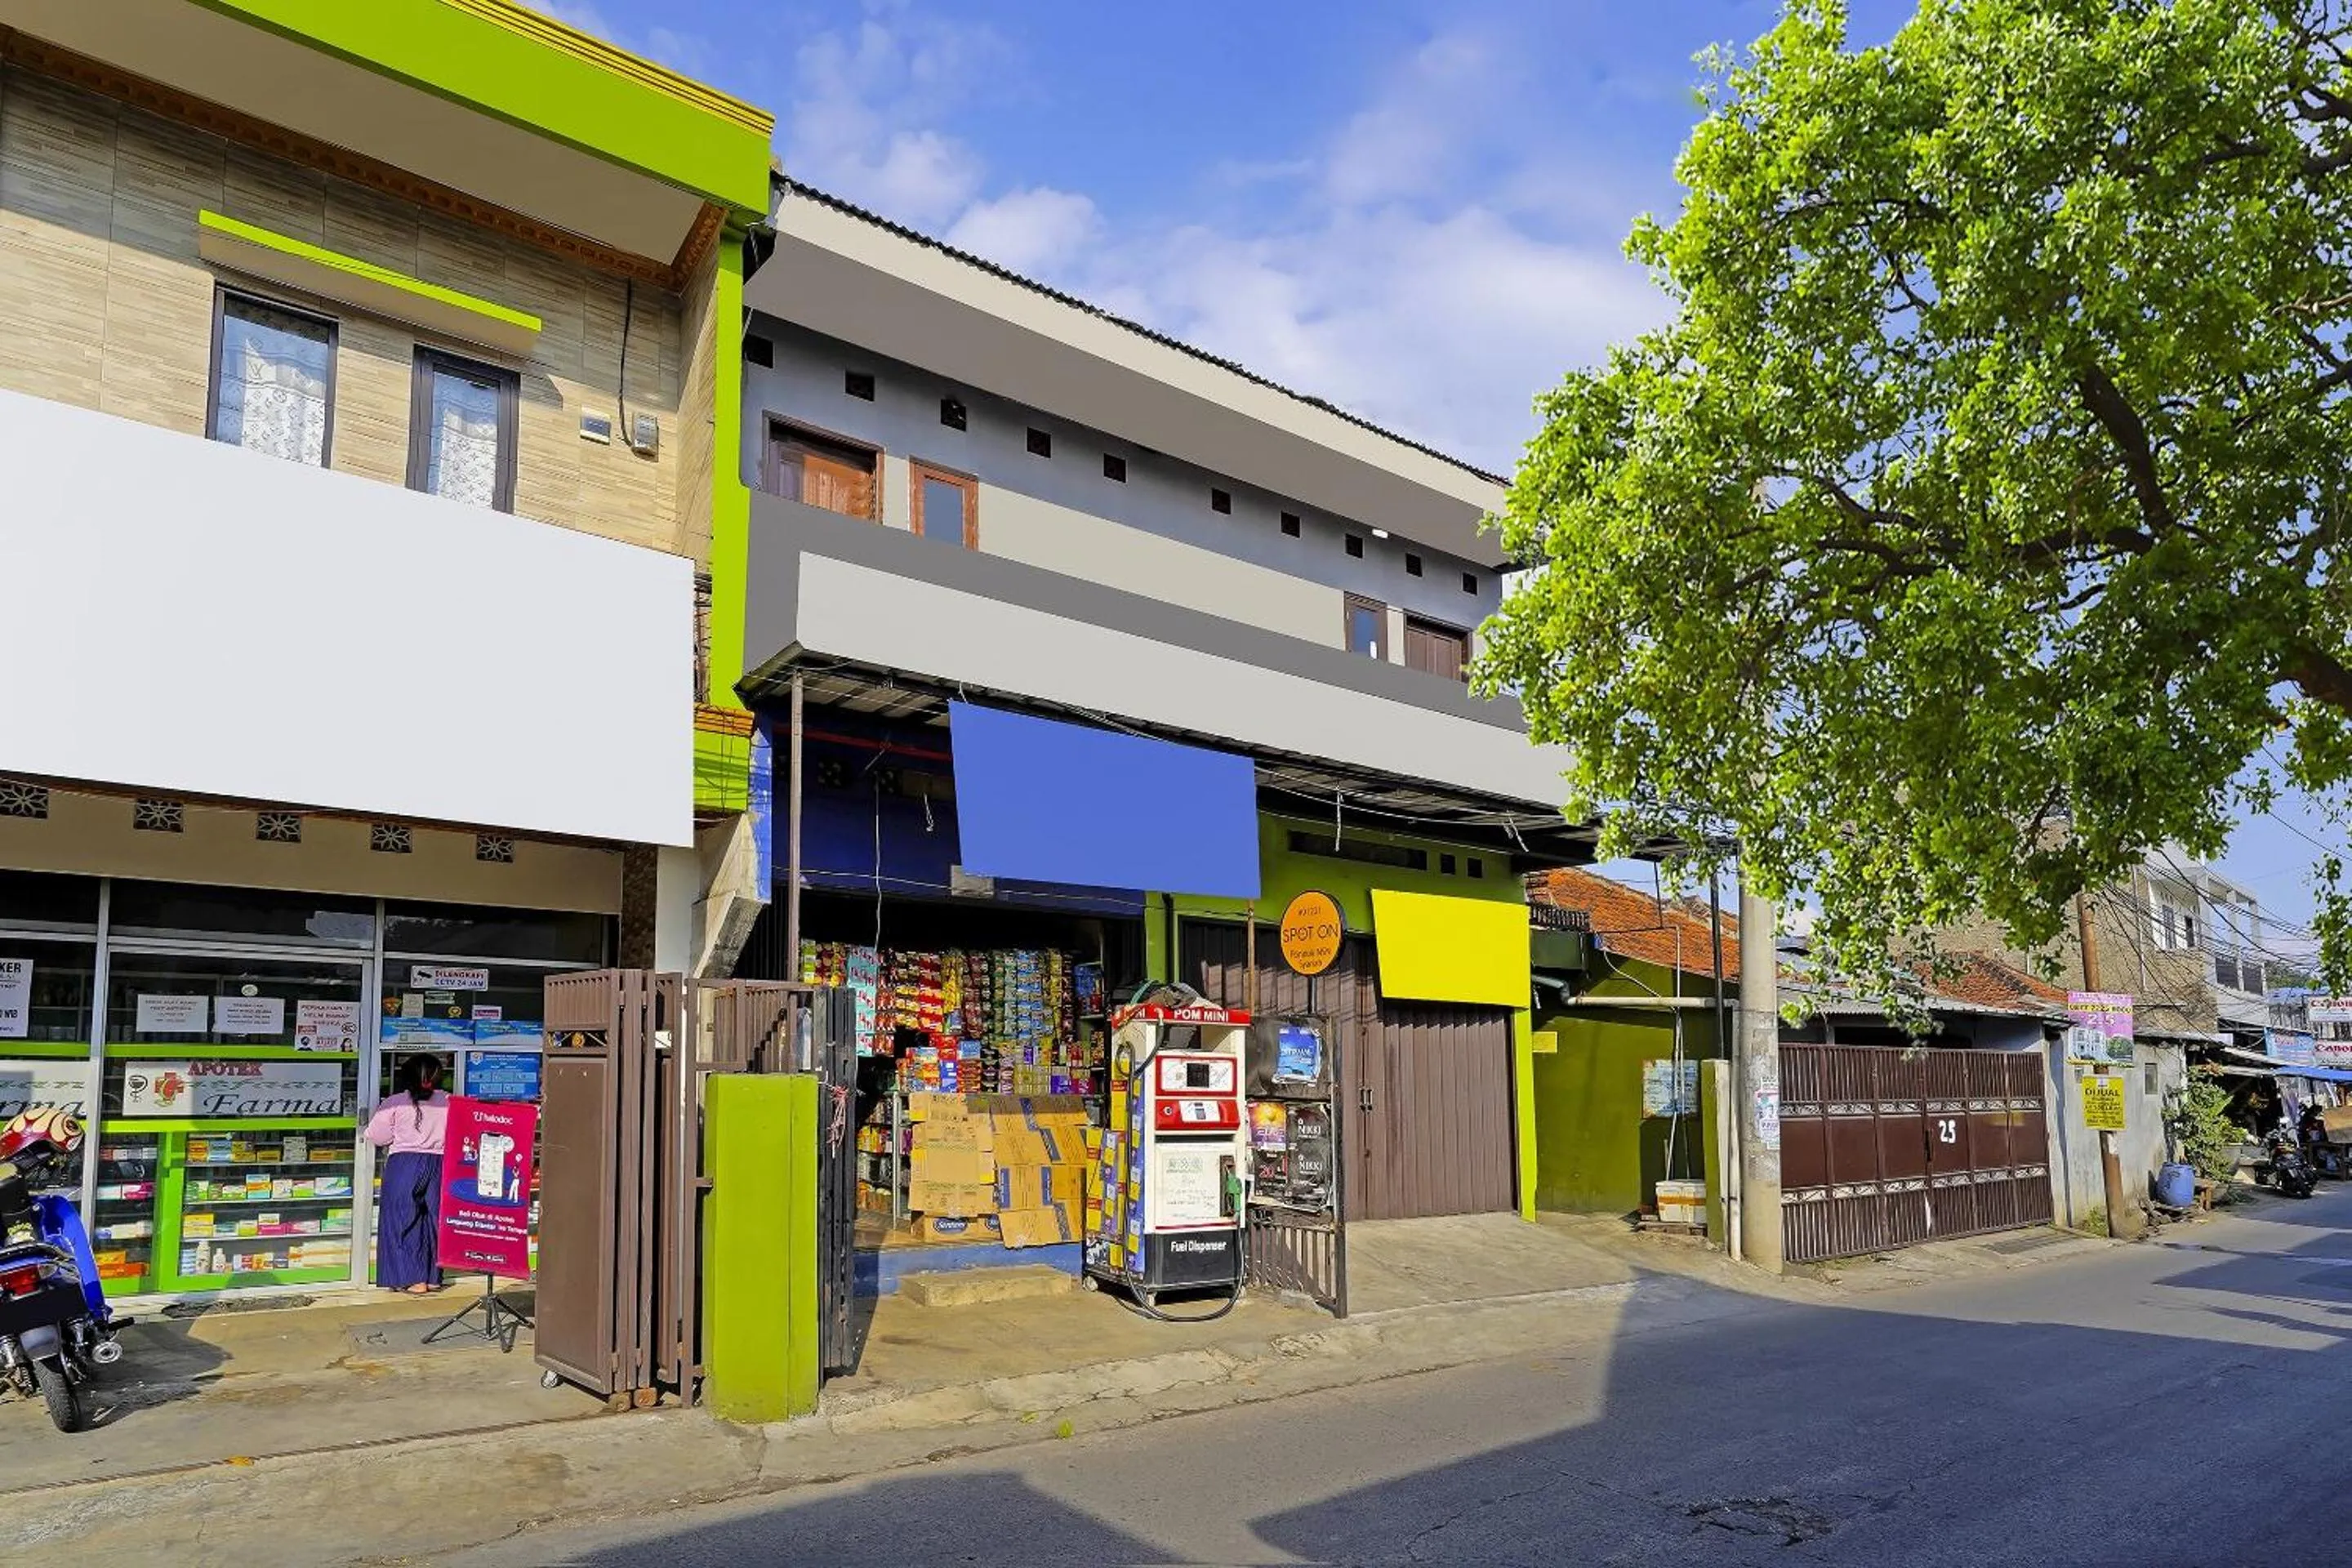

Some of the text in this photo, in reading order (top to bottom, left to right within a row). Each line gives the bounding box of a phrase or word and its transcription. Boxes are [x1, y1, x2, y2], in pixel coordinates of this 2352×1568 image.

[1282, 924, 1339, 943] SPOT ON
[1174, 1009, 1229, 1022] POM MINI
[188, 1062, 264, 1076] APOTEK
[203, 1094, 339, 1116] Farma
[1938, 1119, 1957, 1143] 25
[1170, 1240, 1227, 1254] Fuel Dispenser
